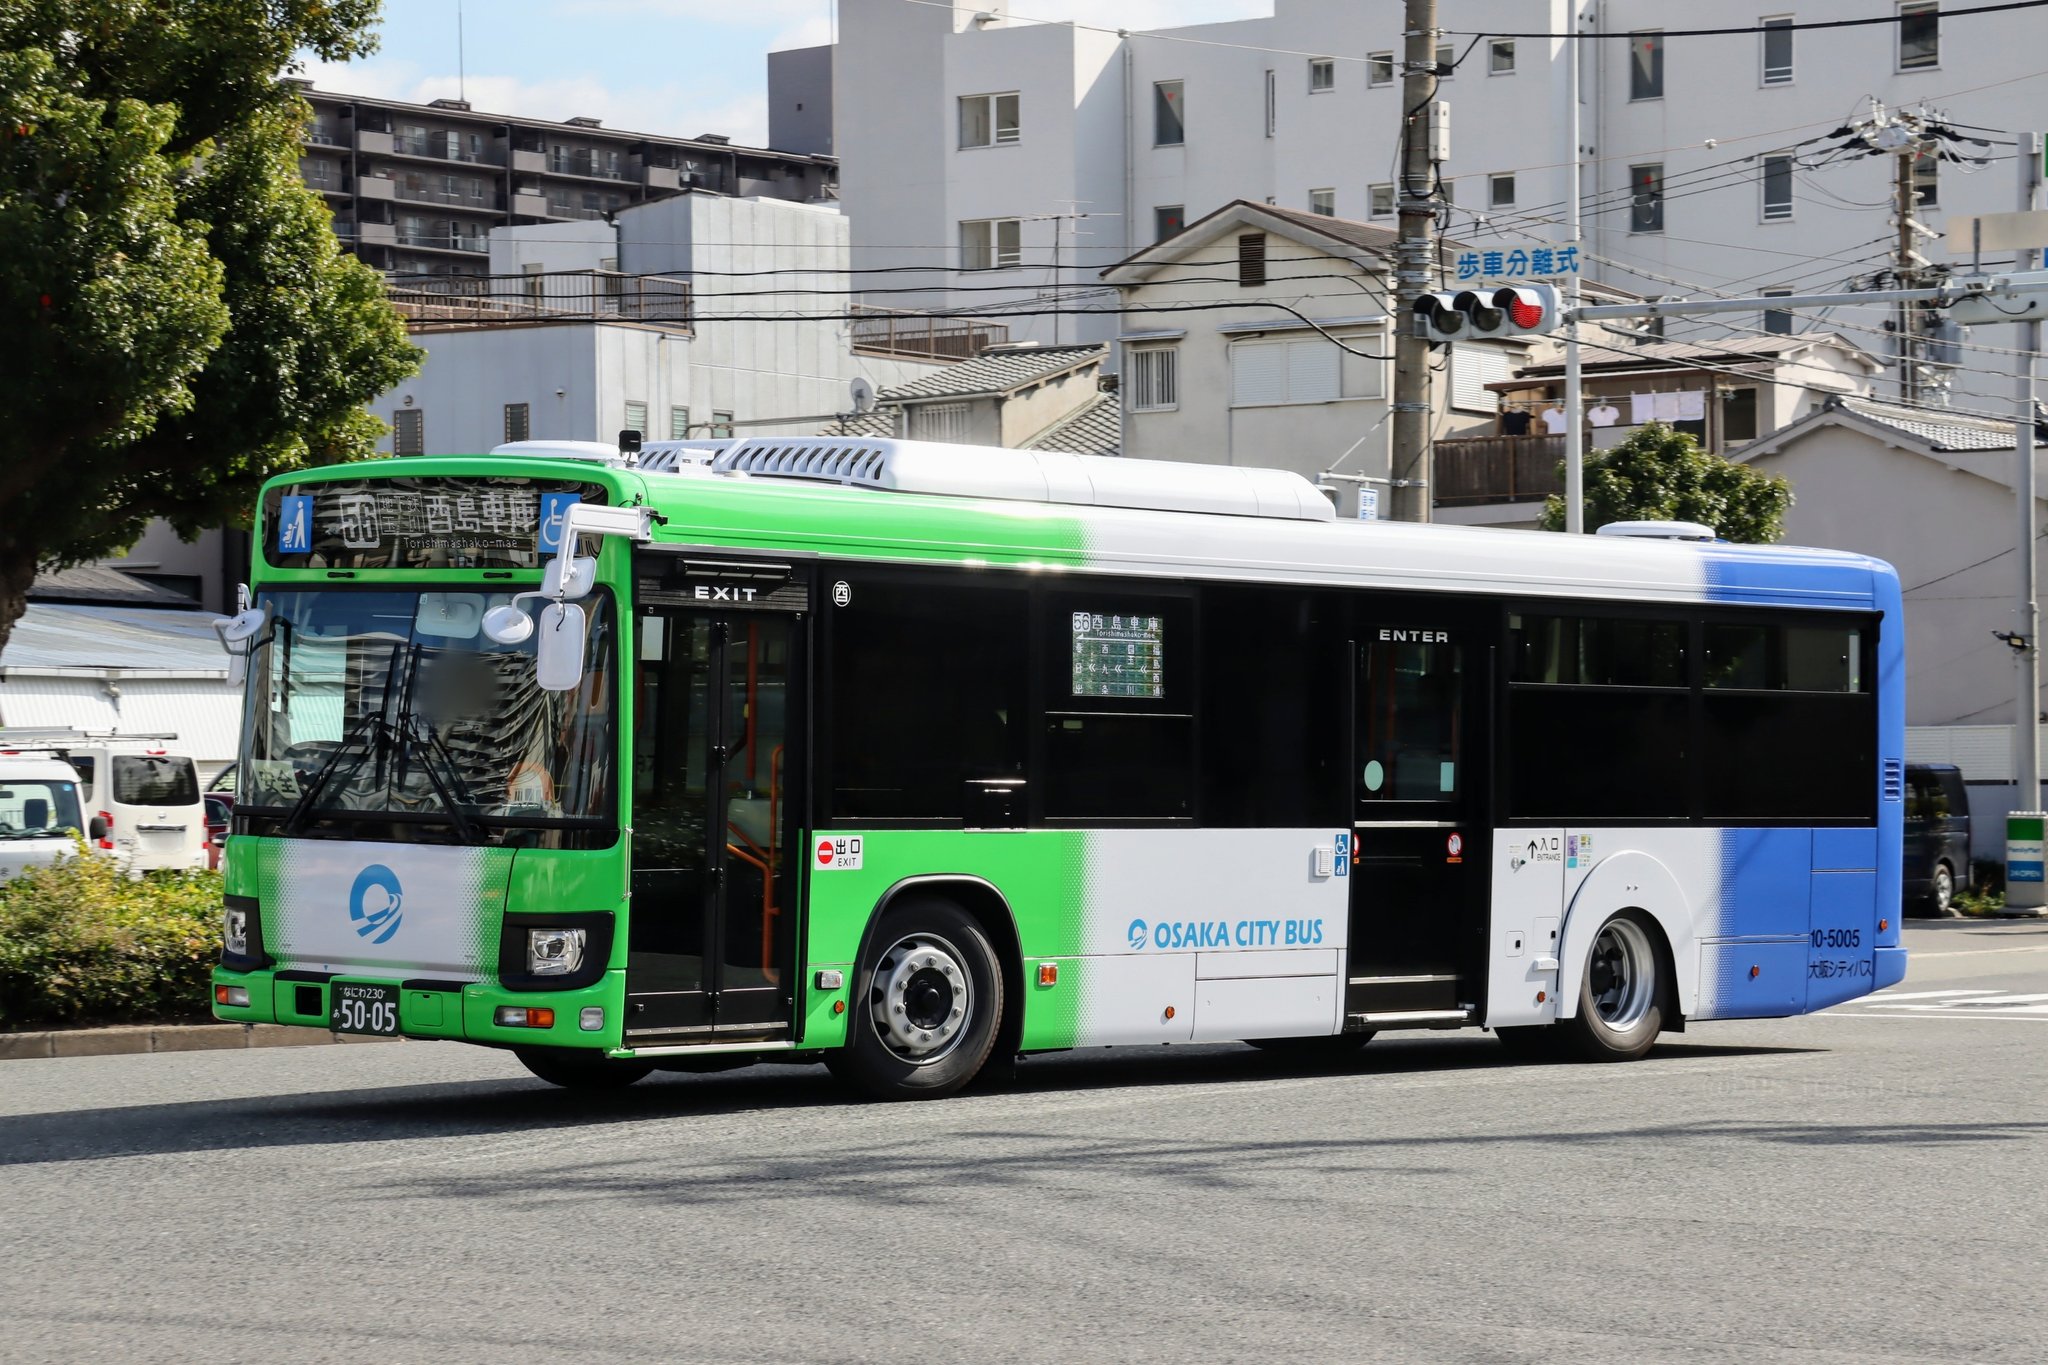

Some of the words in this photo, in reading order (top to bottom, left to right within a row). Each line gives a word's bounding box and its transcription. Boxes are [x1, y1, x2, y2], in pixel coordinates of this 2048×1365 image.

[1457, 247, 1579, 280] 歩車分離式
[423, 489, 537, 533] 酉島車庫
[342, 501, 378, 542] 56
[403, 537, 518, 548] Torishimashako-mae
[694, 585, 757, 602] EXIT
[834, 583, 850, 604] 酉
[1074, 614, 1090, 630] 56
[1092, 614, 1159, 631] 酉島車庫
[1379, 629, 1449, 643] ENTER
[835, 839, 860, 854] 出口
[1540, 837, 1558, 850] 入口
[838, 858, 856, 866] EXIT
[1537, 853, 1561, 861] ENTRANCE
[1154, 922, 1230, 948] OSAKA
[1235, 920, 1280, 946] CITY
[1285, 919, 1323, 945] BUS
[1811, 929, 1860, 948] 10-5005
[1808, 960, 1872, 979] 大阪シティバス
[333, 1008, 340, 1019] あ
[341, 999, 396, 1032] 50-05
